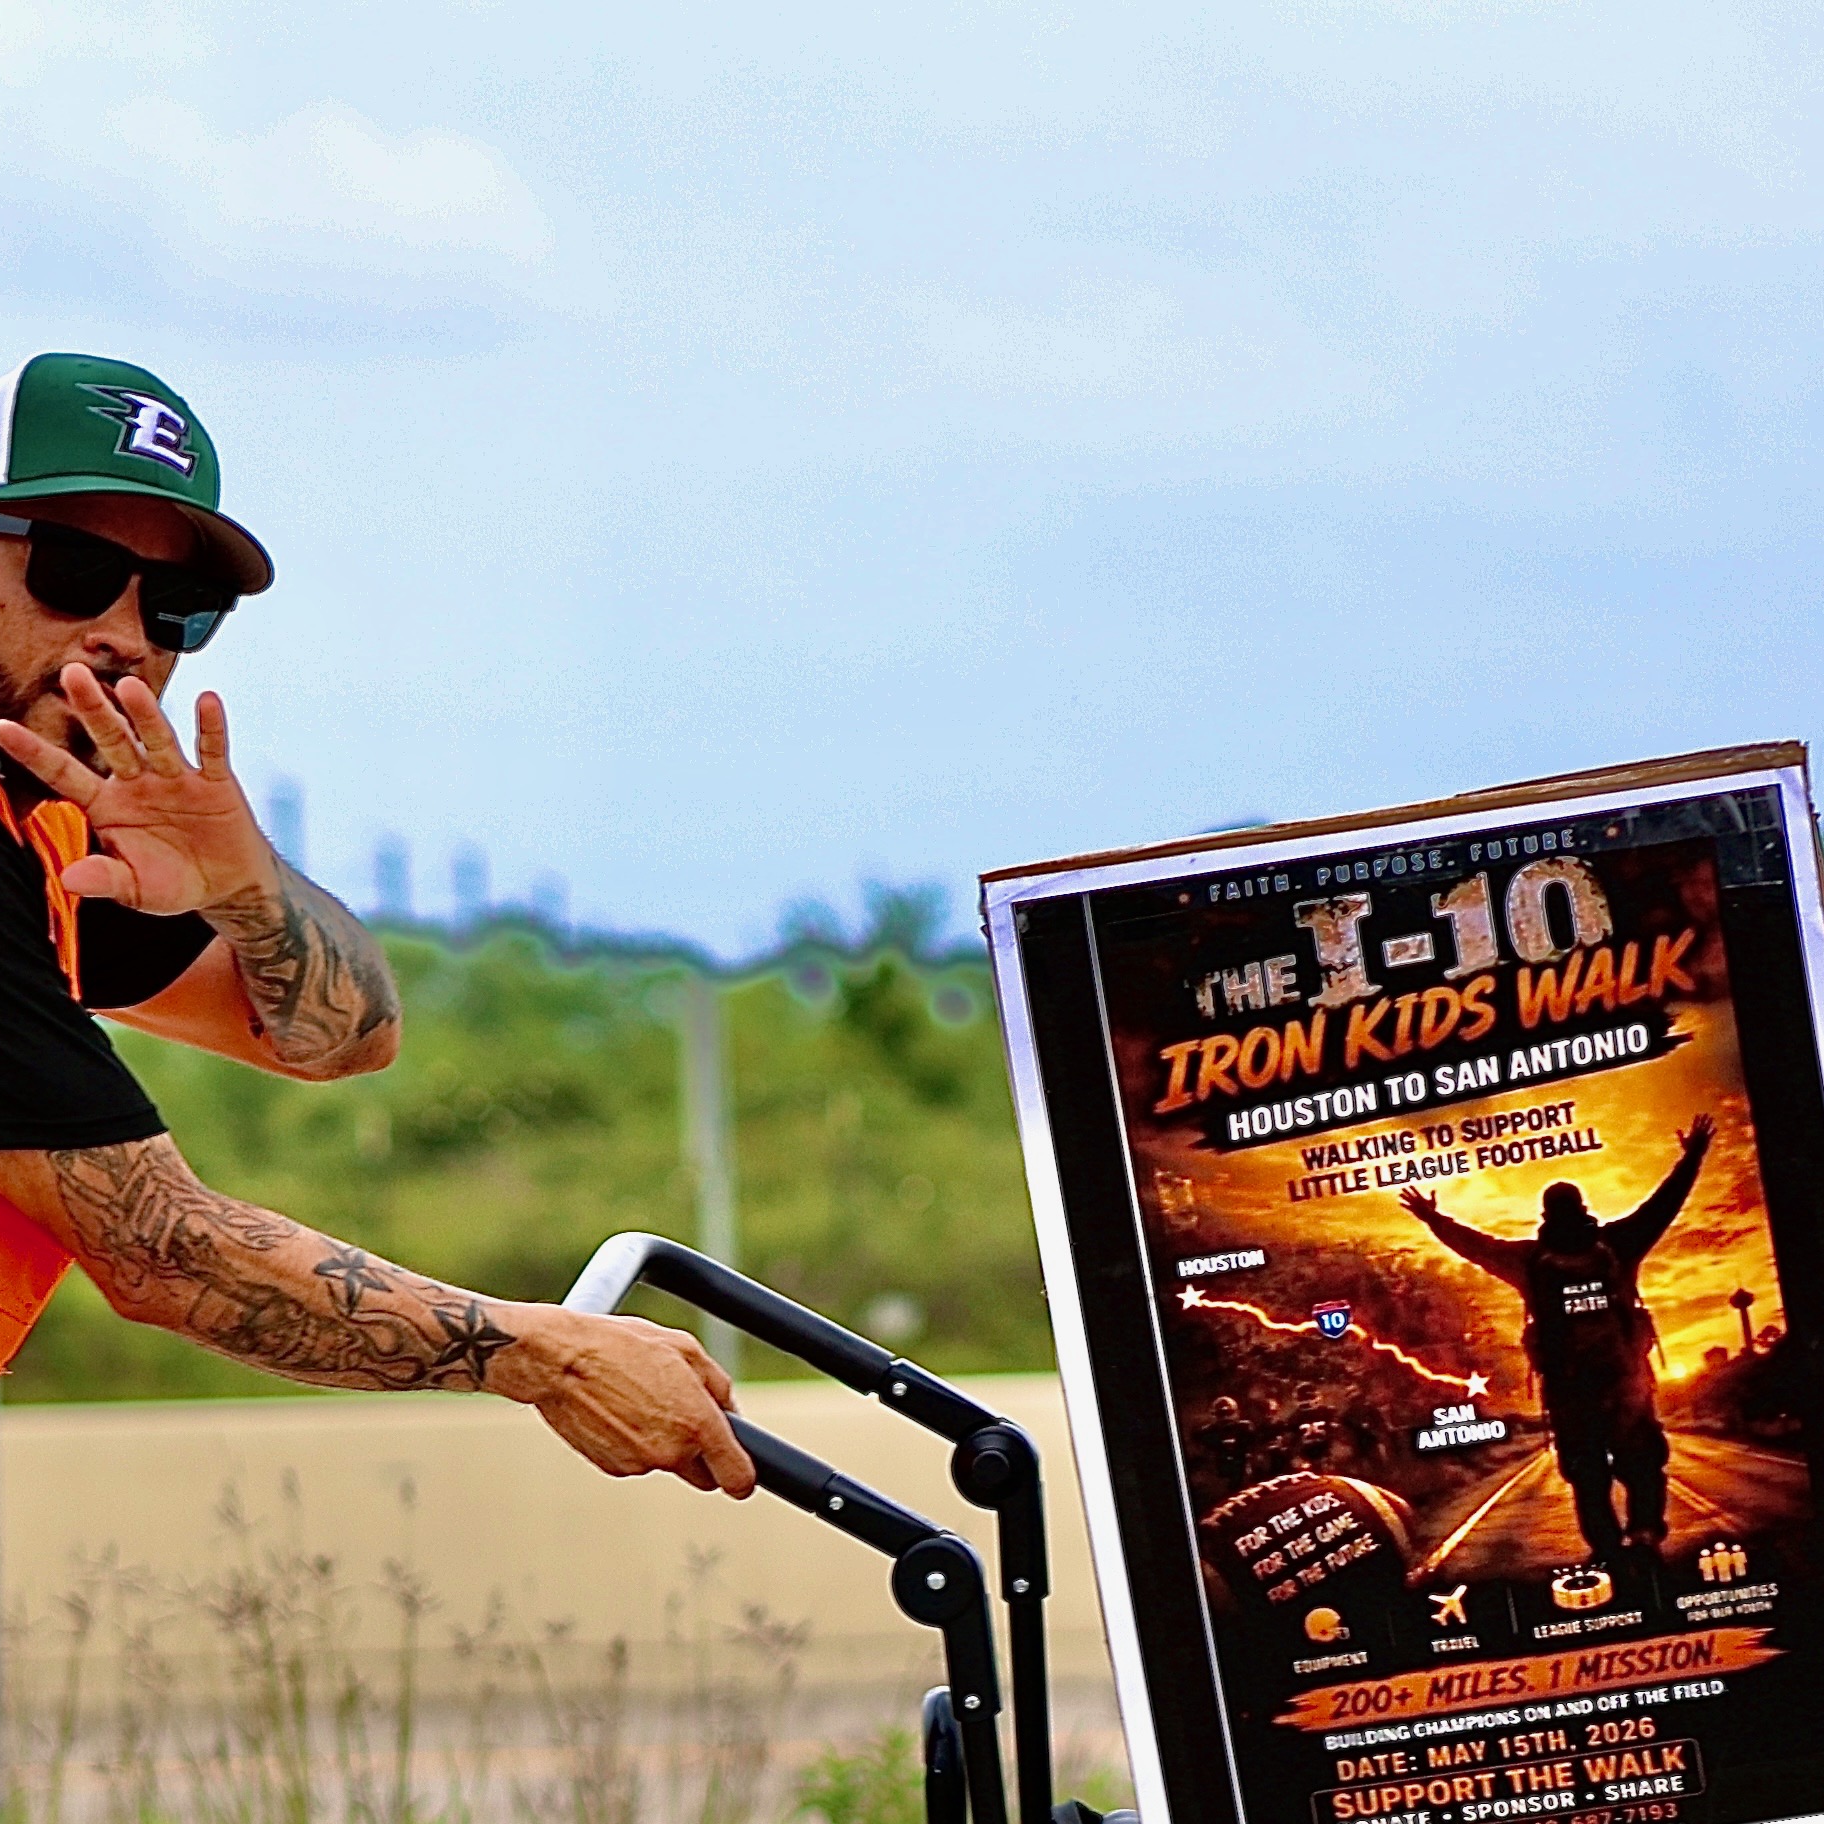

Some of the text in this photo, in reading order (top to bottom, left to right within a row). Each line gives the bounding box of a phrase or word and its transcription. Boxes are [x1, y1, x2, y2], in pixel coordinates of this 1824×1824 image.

[114, 388, 200, 480] E
[1209, 829, 1588, 902] FAITH. PURPOSE. FUTURE.
[1185, 856, 1613, 1019] THE I-10
[1154, 929, 1696, 1115] IRON KIDS WALK
[1228, 1024, 1650, 1141] HOUSTON TO SAN ANTONIO
[1288, 1128, 1601, 1202] LITTLE LEAGUE FOOTBALL
[1301, 1102, 1575, 1170] WALKING TO SUPPORT
[1178, 1250, 1265, 1277] HOUSTON
[1322, 1313, 1345, 1329] 10
[1418, 1421, 1506, 1450] ANTONIO
[1433, 1405, 1476, 1426] SAN
[1234, 1526, 1272, 1557] FOR
[1268, 1508, 1302, 1534] THE
[1252, 1552, 1288, 1580] FOR
[1286, 1537, 1317, 1564] THE
[1267, 1579, 1299, 1601] FOR
[1295, 1563, 1327, 1586] THE
[1534, 1611, 1642, 1640] LEAGUE SUPPORT
[1331, 1635, 1723, 1720] 200+ MILES. 1 MISSION.
[1324, 1725, 1410, 1751] BUILDING
[1414, 1704, 1520, 1738] CHAMPIONS
[1525, 1704, 1551, 1722] ON
[1555, 1696, 1592, 1718] AND
[1598, 1693, 1631, 1713] OFF
[1635, 1687, 1670, 1707] THE
[1337, 1753, 1417, 1782] DATE:
[1428, 1742, 1485, 1768] MAY
[1586, 1717, 1656, 1744] 2026
[1333, 1744, 1685, 1819] SUPPORT THE WALK
[1463, 1791, 1575, 1822] SPONSOR
[1605, 1776, 1685, 1801] SHARE
